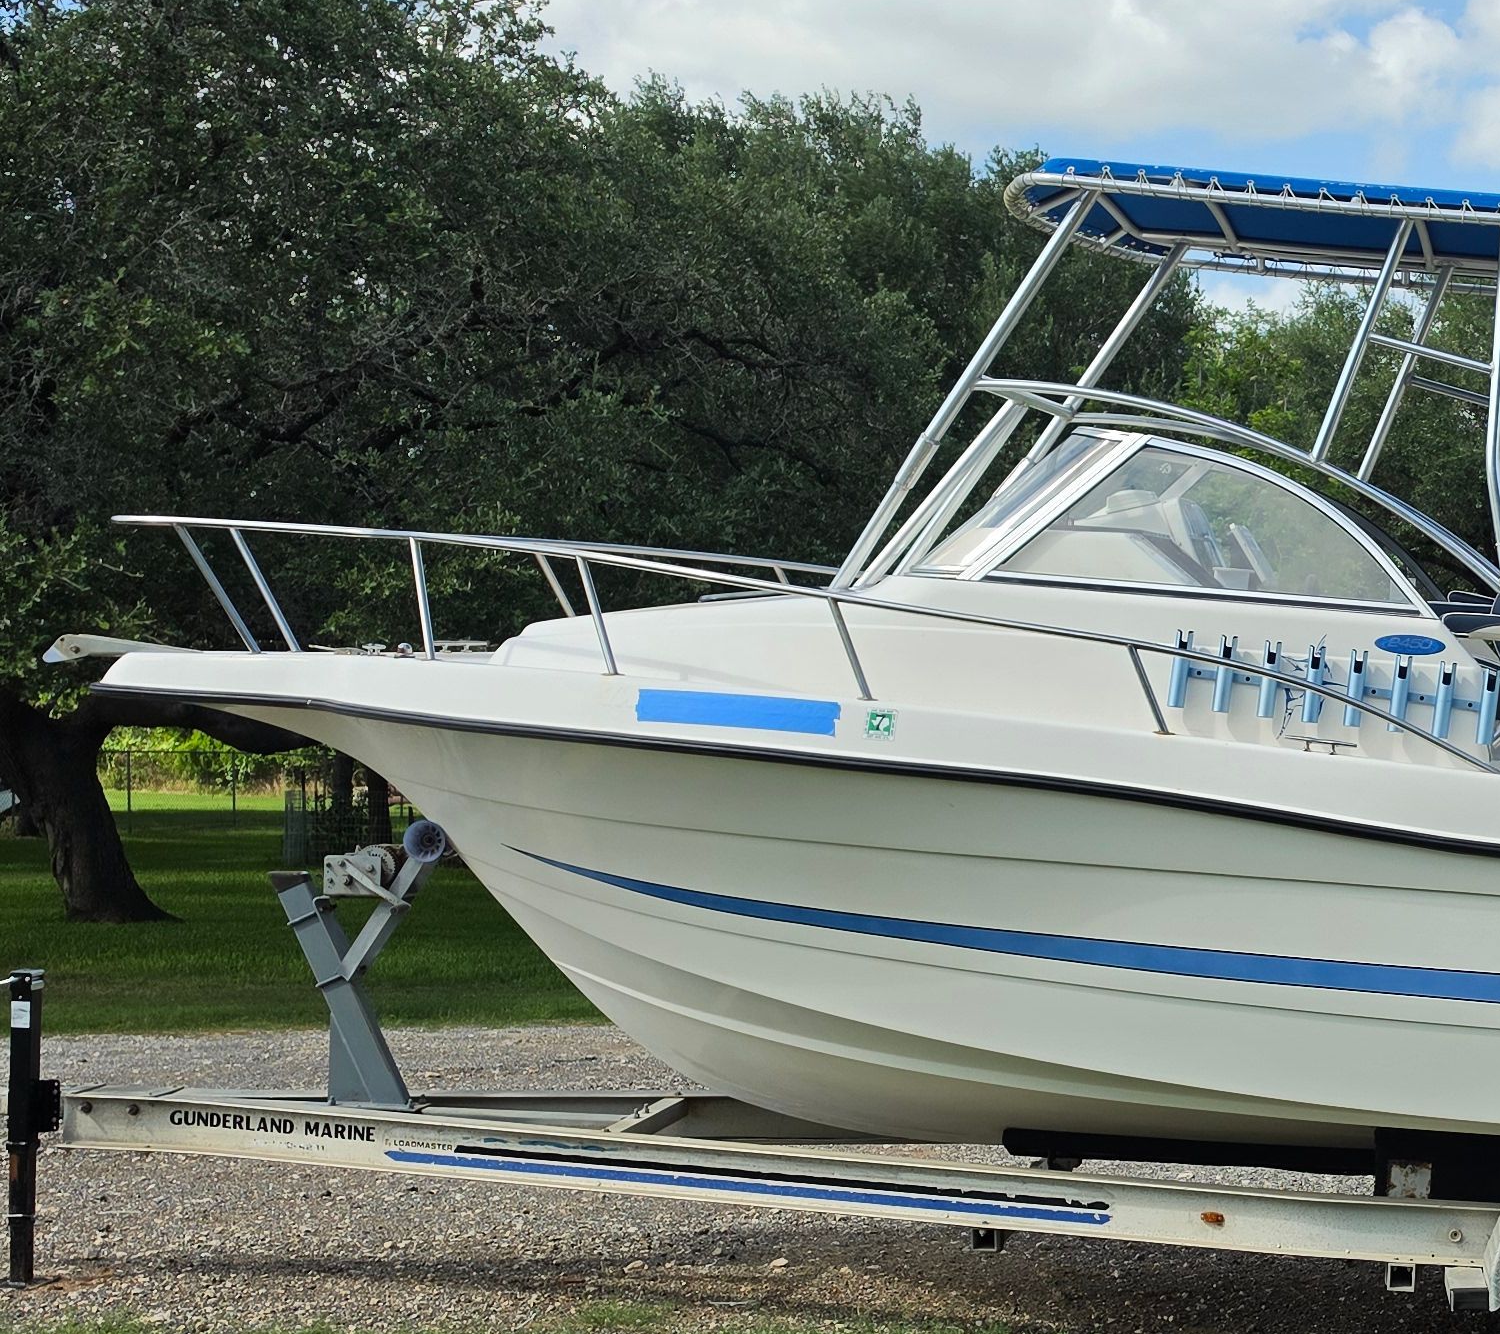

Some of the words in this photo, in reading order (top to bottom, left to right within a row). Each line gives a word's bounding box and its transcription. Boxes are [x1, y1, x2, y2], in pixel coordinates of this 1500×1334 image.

[1388, 637, 1433, 650] 2450
[875, 713, 886, 731] 7
[169, 1109, 294, 1134] GUNDERLAND
[305, 1122, 376, 1142] MARINE
[393, 1139, 453, 1151] LOADMASTER
